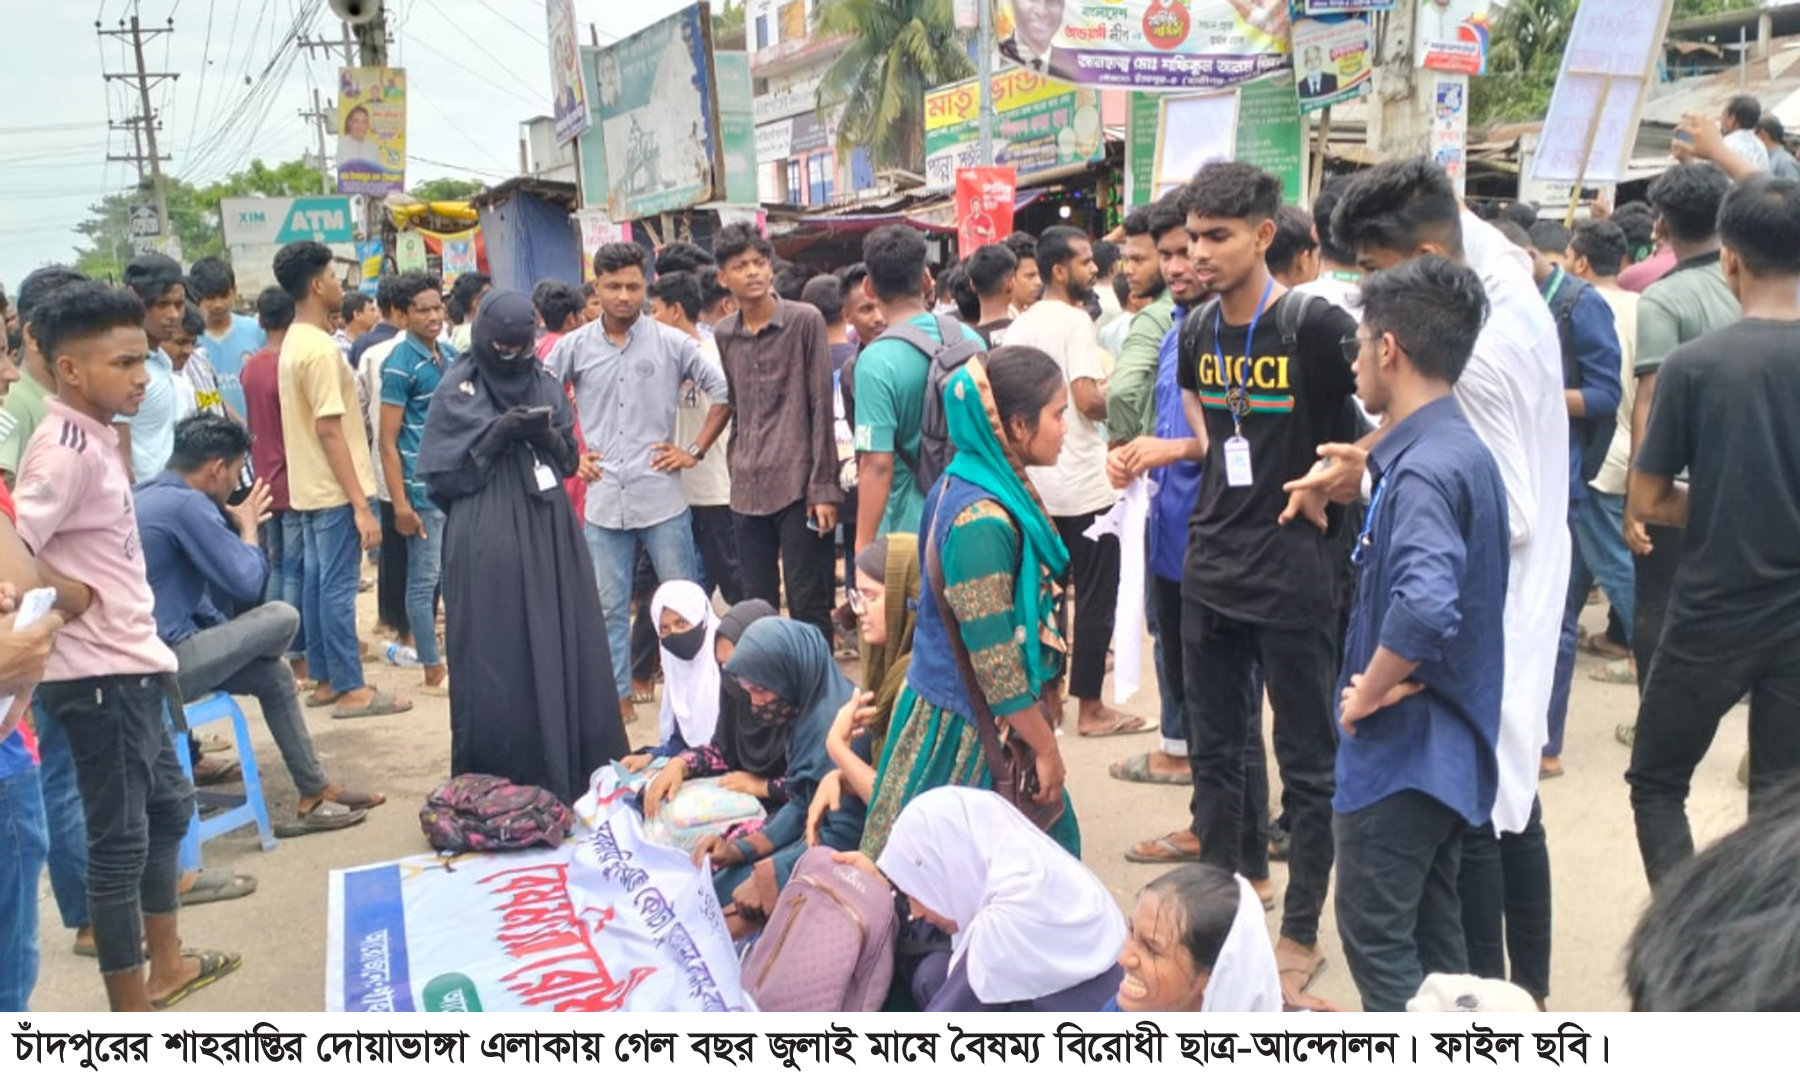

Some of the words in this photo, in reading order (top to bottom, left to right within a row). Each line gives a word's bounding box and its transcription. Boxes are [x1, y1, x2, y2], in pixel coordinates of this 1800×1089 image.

[927, 89, 973, 120] মাতৃ
[290, 209, 345, 232] ATM
[1199, 353, 1290, 389] GUCCI
[634, 886, 677, 935] কোটা
